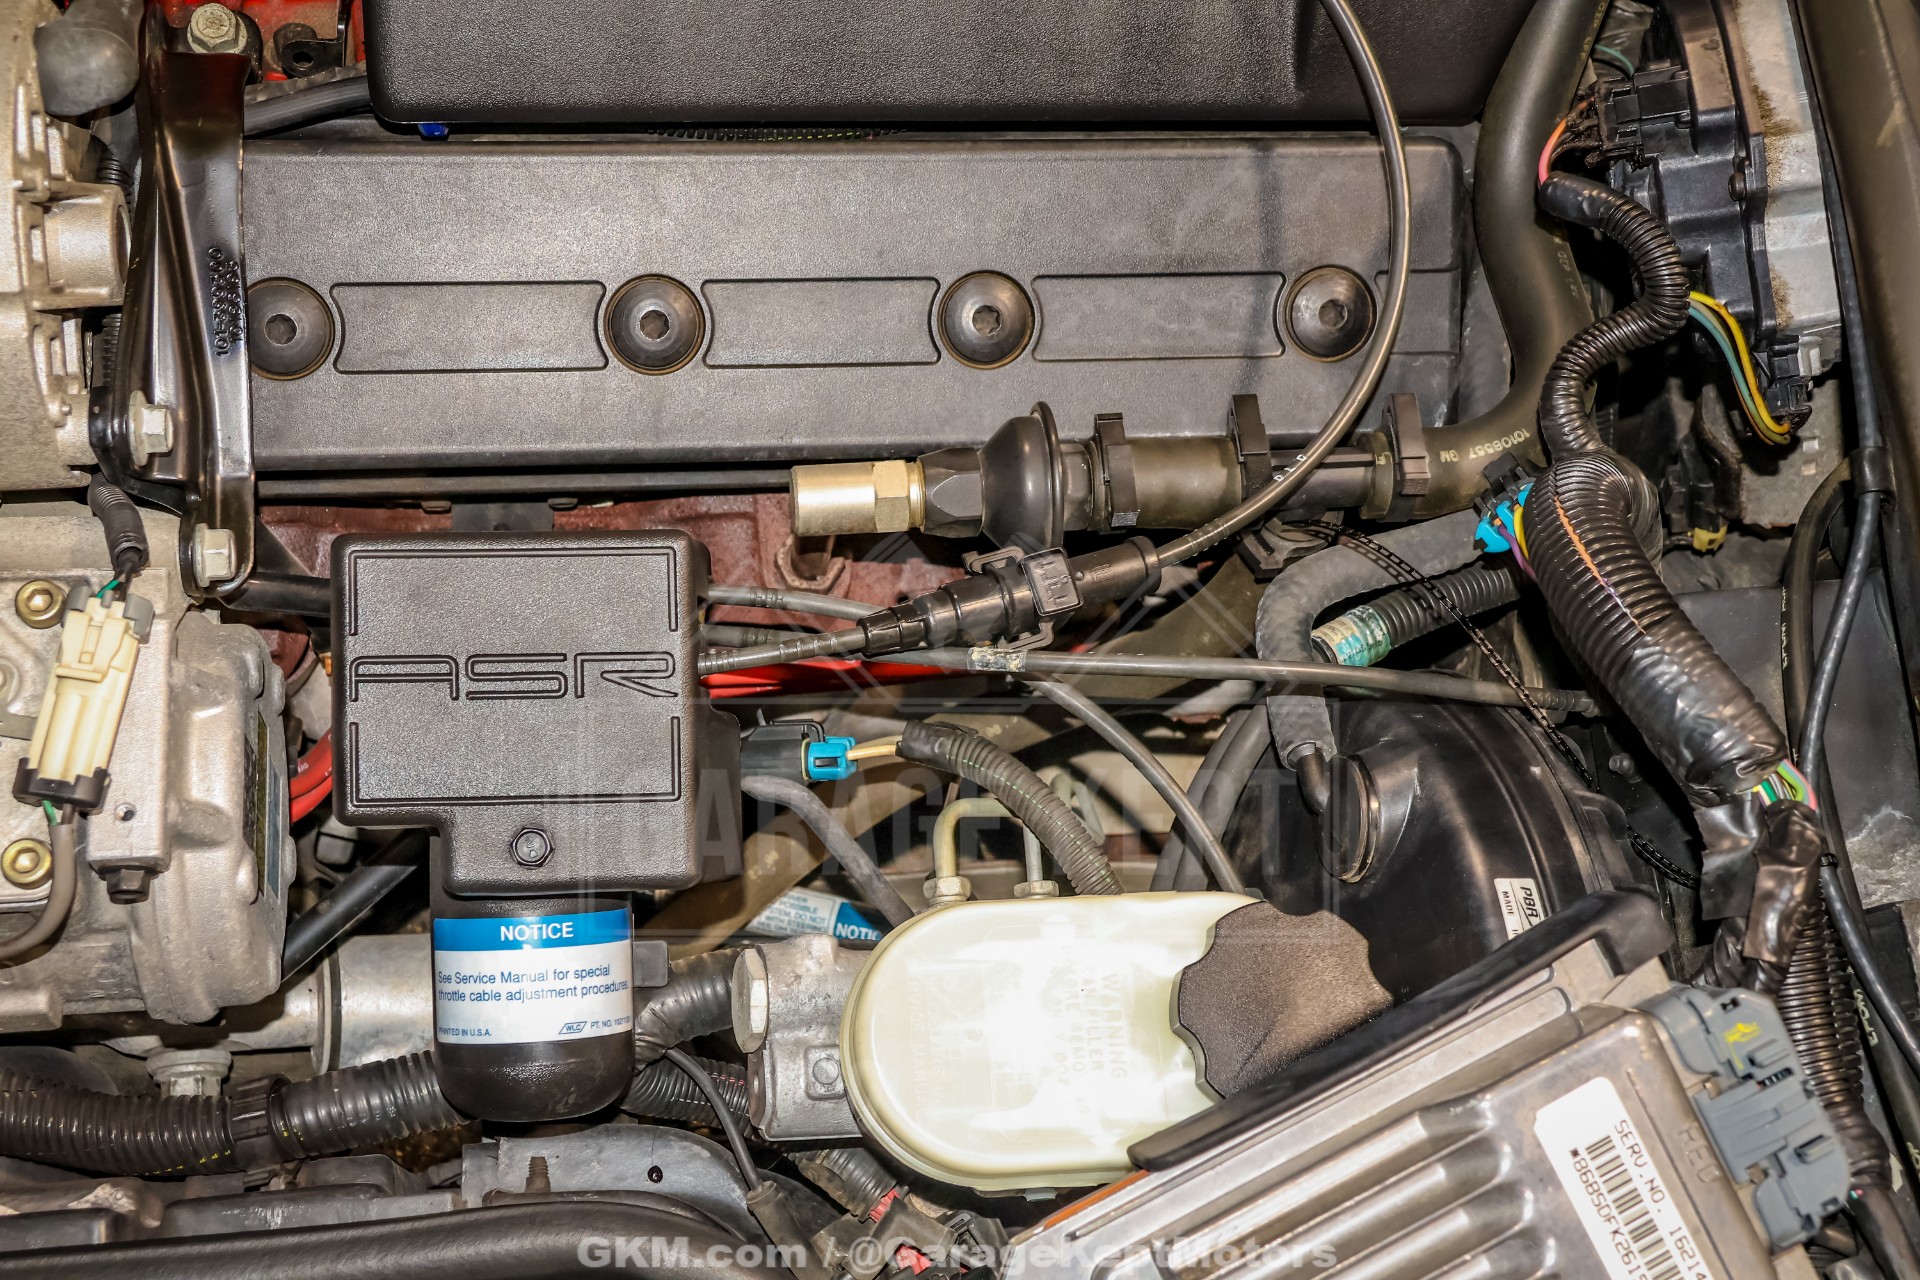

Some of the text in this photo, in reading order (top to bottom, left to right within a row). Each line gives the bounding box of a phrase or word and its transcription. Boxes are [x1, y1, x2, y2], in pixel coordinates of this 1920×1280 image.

[349, 651, 679, 701] ASR
[1501, 891, 1515, 917] MADE
[500, 921, 574, 941] NOTICE
[835, 922, 880, 941] NOTIC
[438, 964, 610, 985] See Service Manual for special
[438, 989, 466, 1002] throttle
[469, 989, 501, 1002] cable
[506, 985, 577, 1004] adjustment
[438, 1026, 492, 1037] PRINTED IN U.S.A.
[565, 1023, 582, 1033] WLC
[590, 1020, 601, 1030] PT.
[601, 1018, 613, 1029] NO.
[1101, 973, 1129, 1080] WARNING
